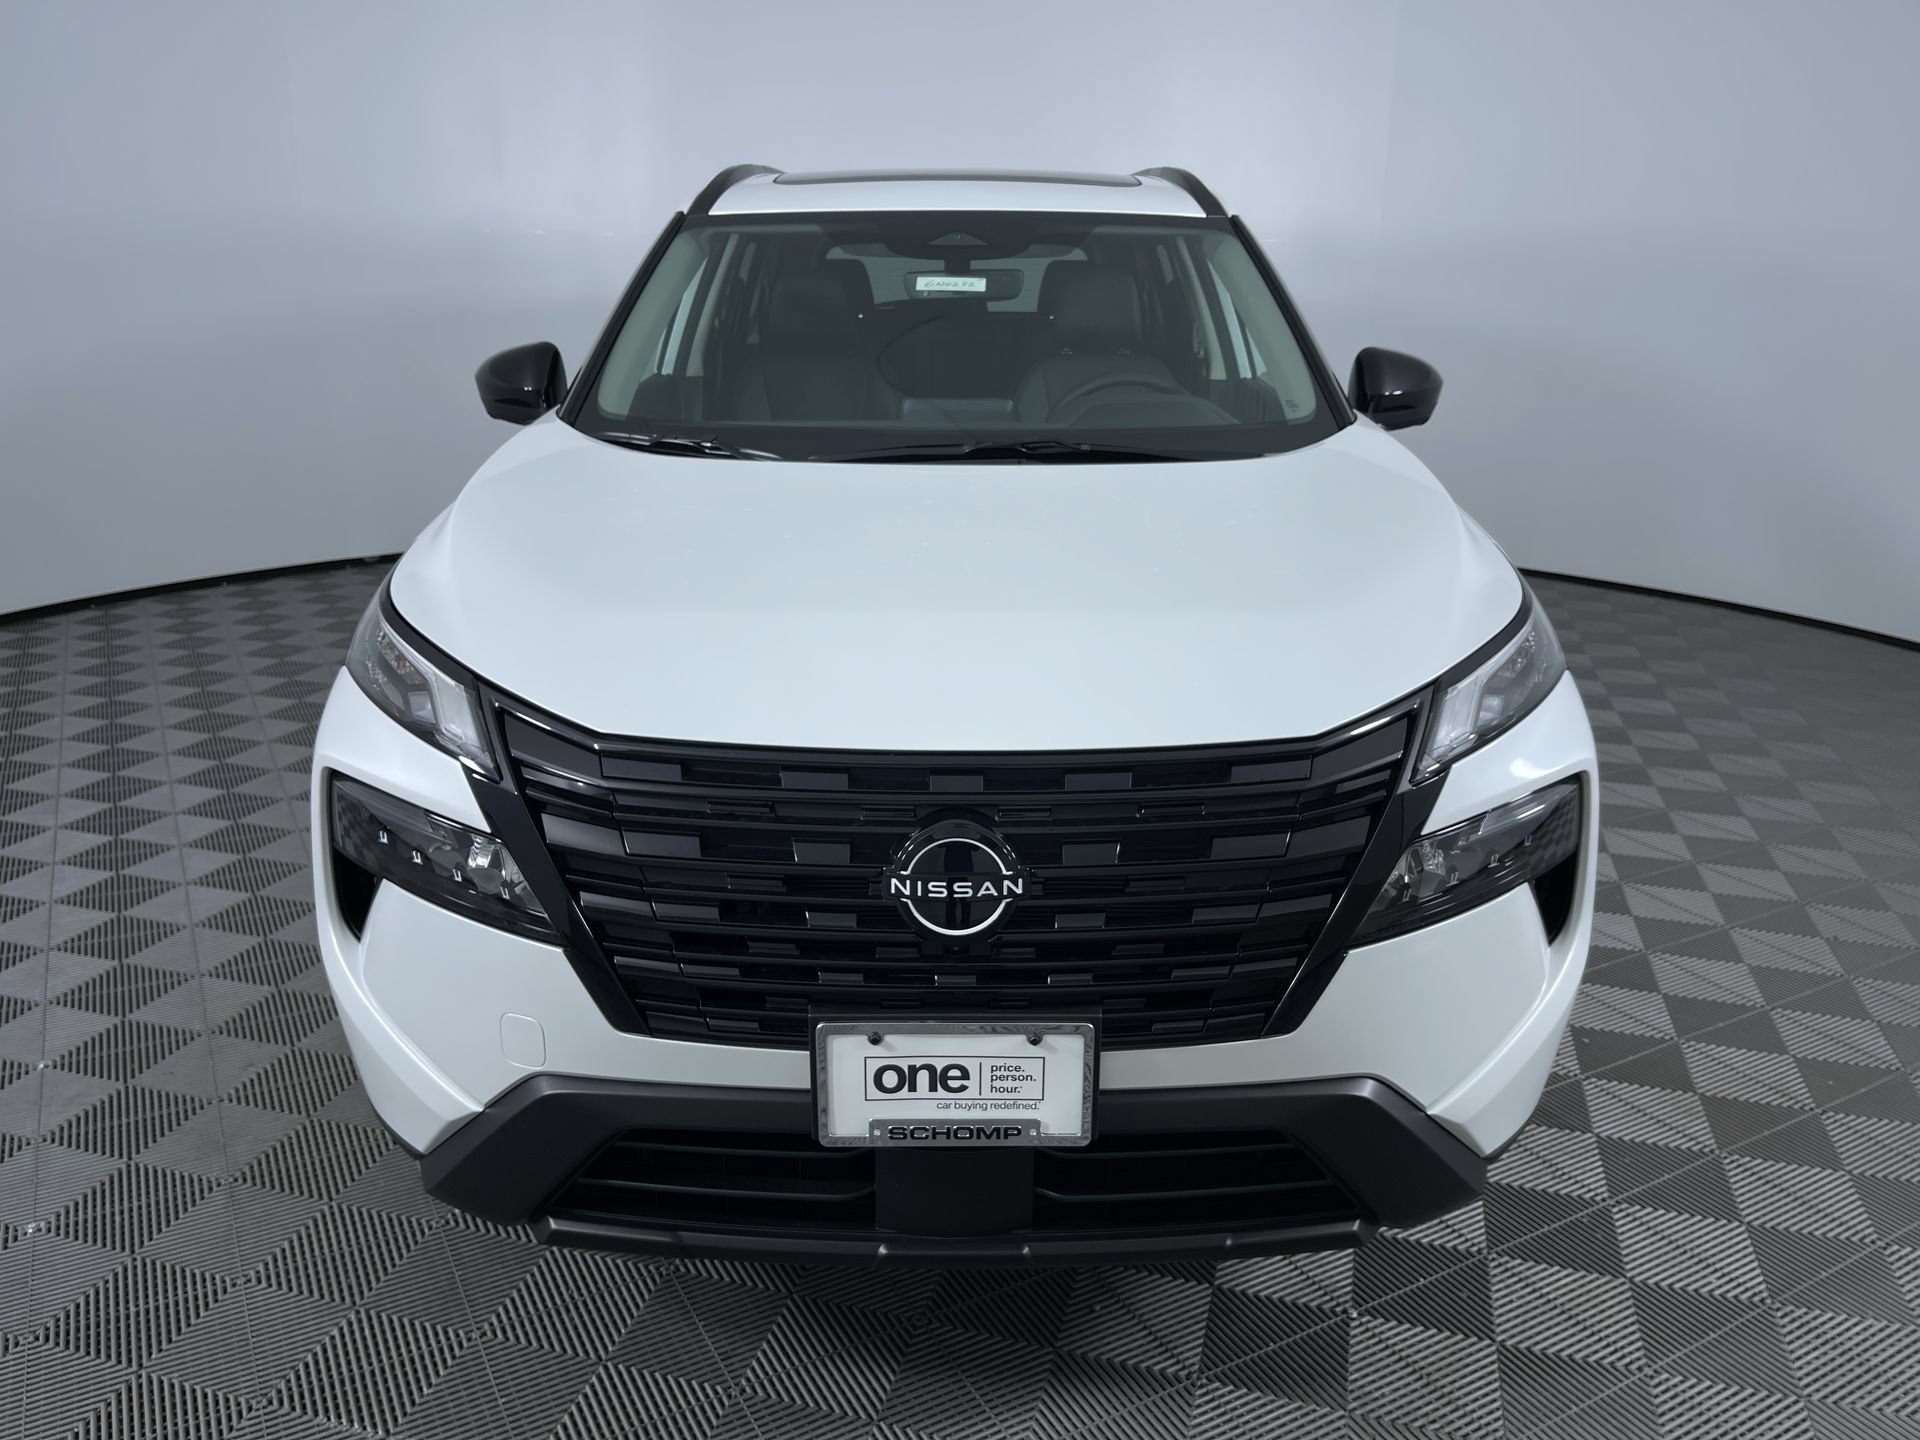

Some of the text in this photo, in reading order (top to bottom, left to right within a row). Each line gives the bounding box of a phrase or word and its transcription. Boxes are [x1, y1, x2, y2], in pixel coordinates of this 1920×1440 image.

[891, 878, 1023, 898] NISSAN
[990, 1062, 1025, 1074] price.
[873, 1063, 970, 1094] one
[990, 1074, 1037, 1083] person.
[936, 1100, 1040, 1112] car buying redefined.
[887, 1125, 1022, 1141] SCHOMP
